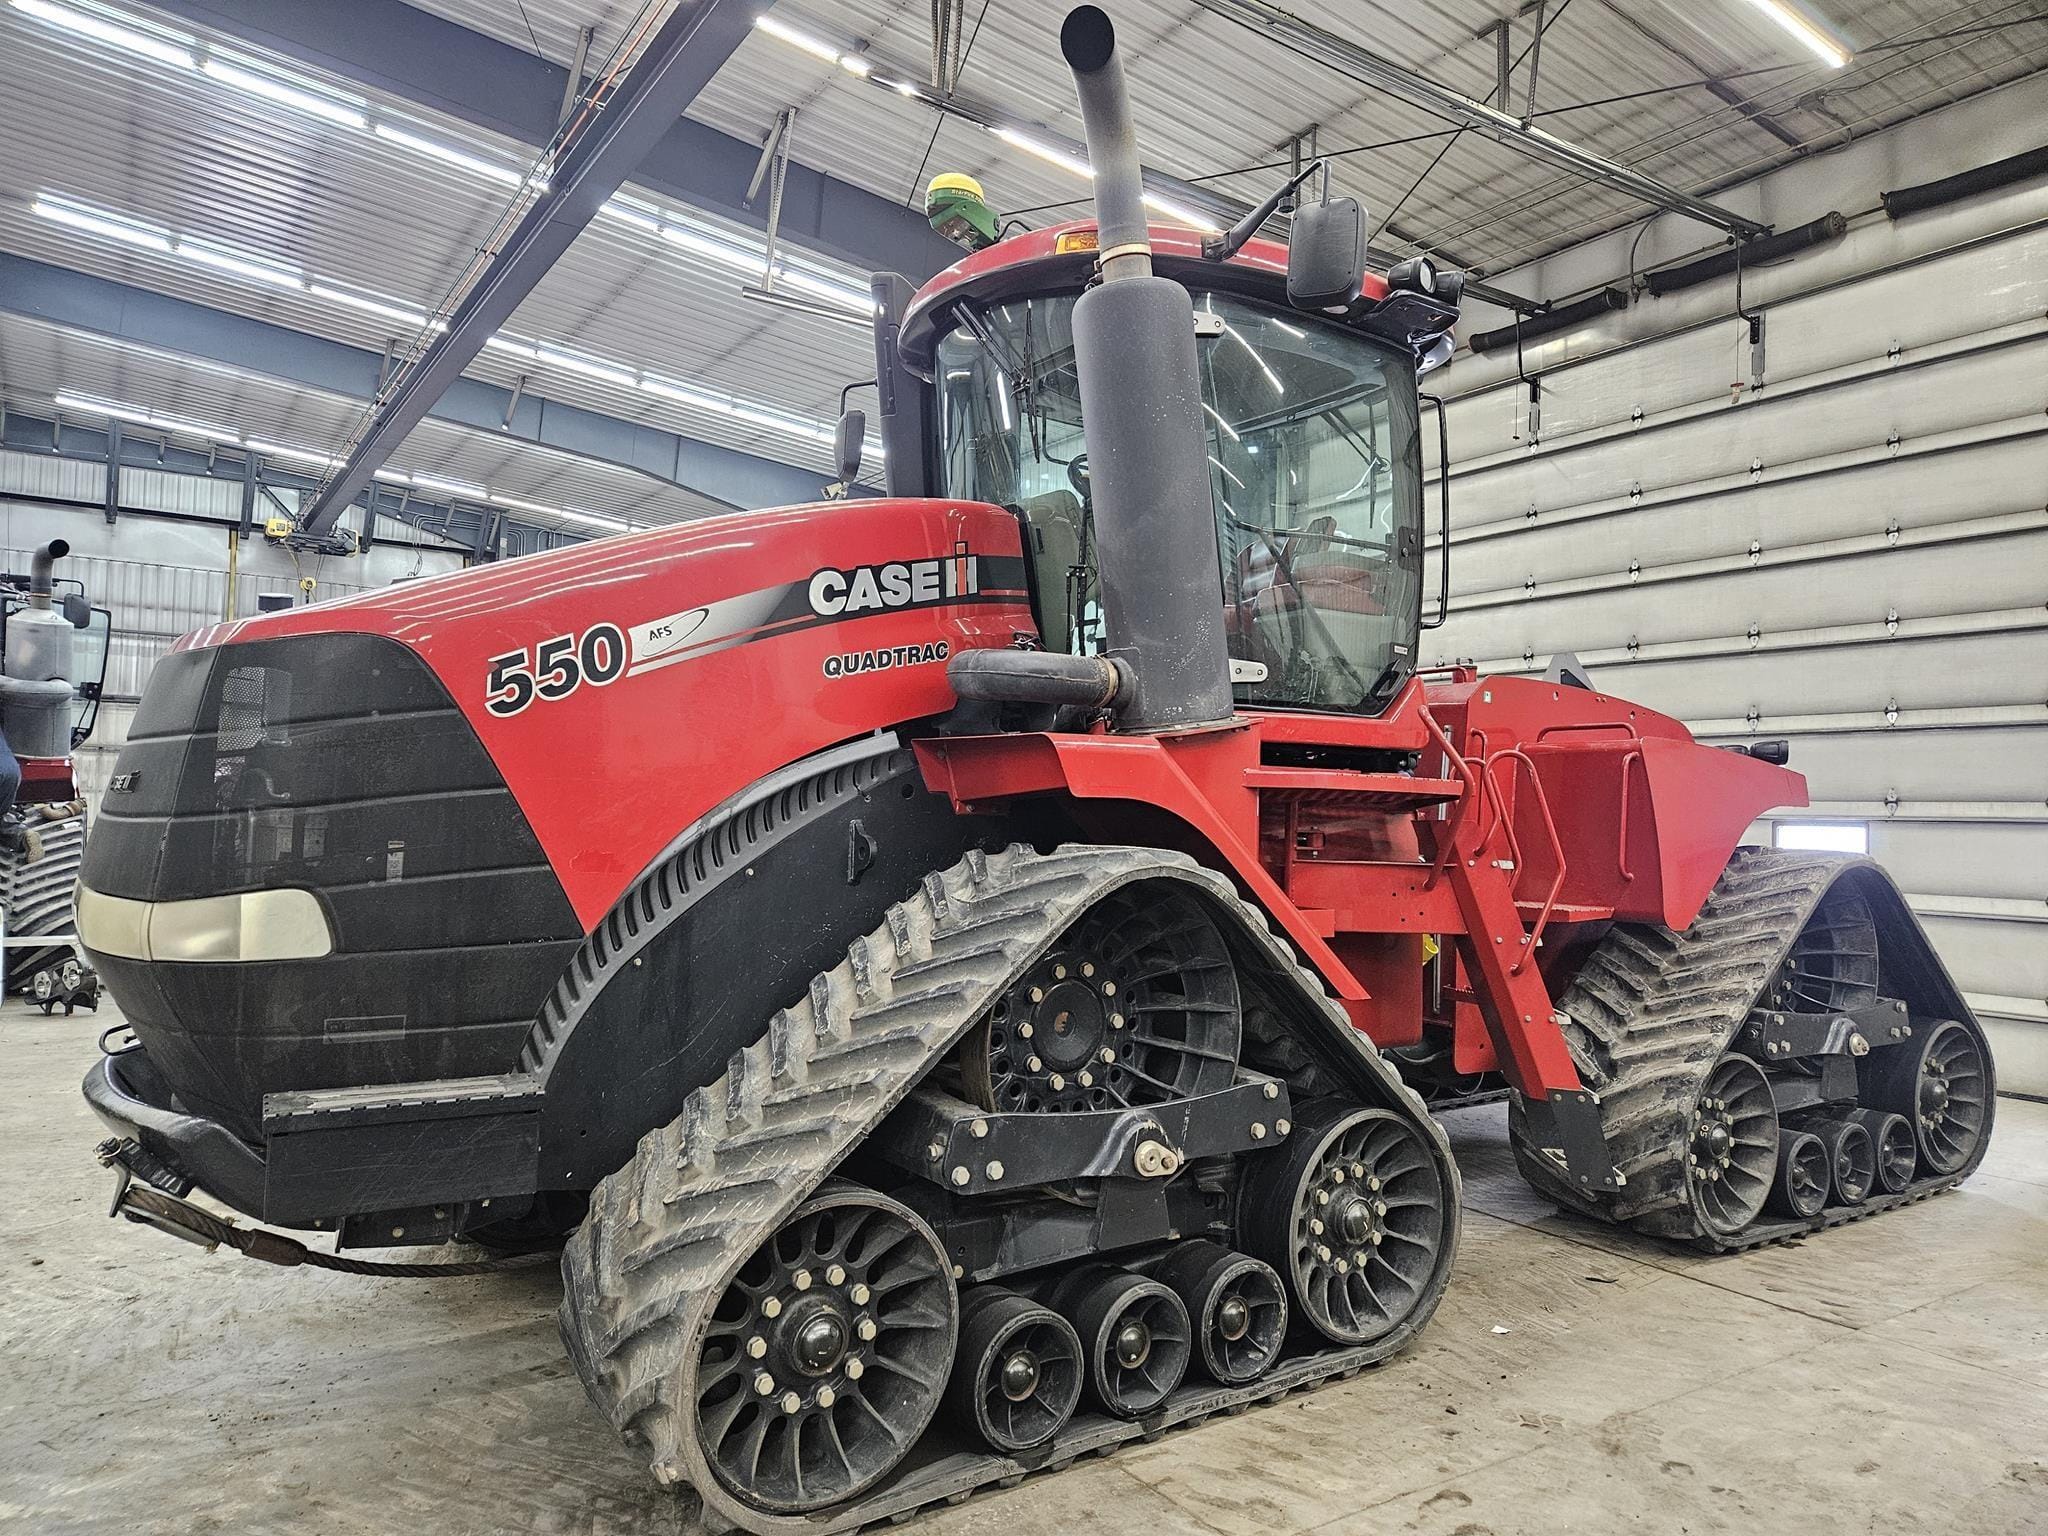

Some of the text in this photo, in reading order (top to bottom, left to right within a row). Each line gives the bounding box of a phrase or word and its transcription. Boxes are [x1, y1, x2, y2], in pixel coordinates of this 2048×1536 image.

[809, 563, 940, 616] CASE
[649, 625, 672, 641] AFS
[484, 622, 627, 718] 550
[823, 640, 950, 679] QUADTRAC
